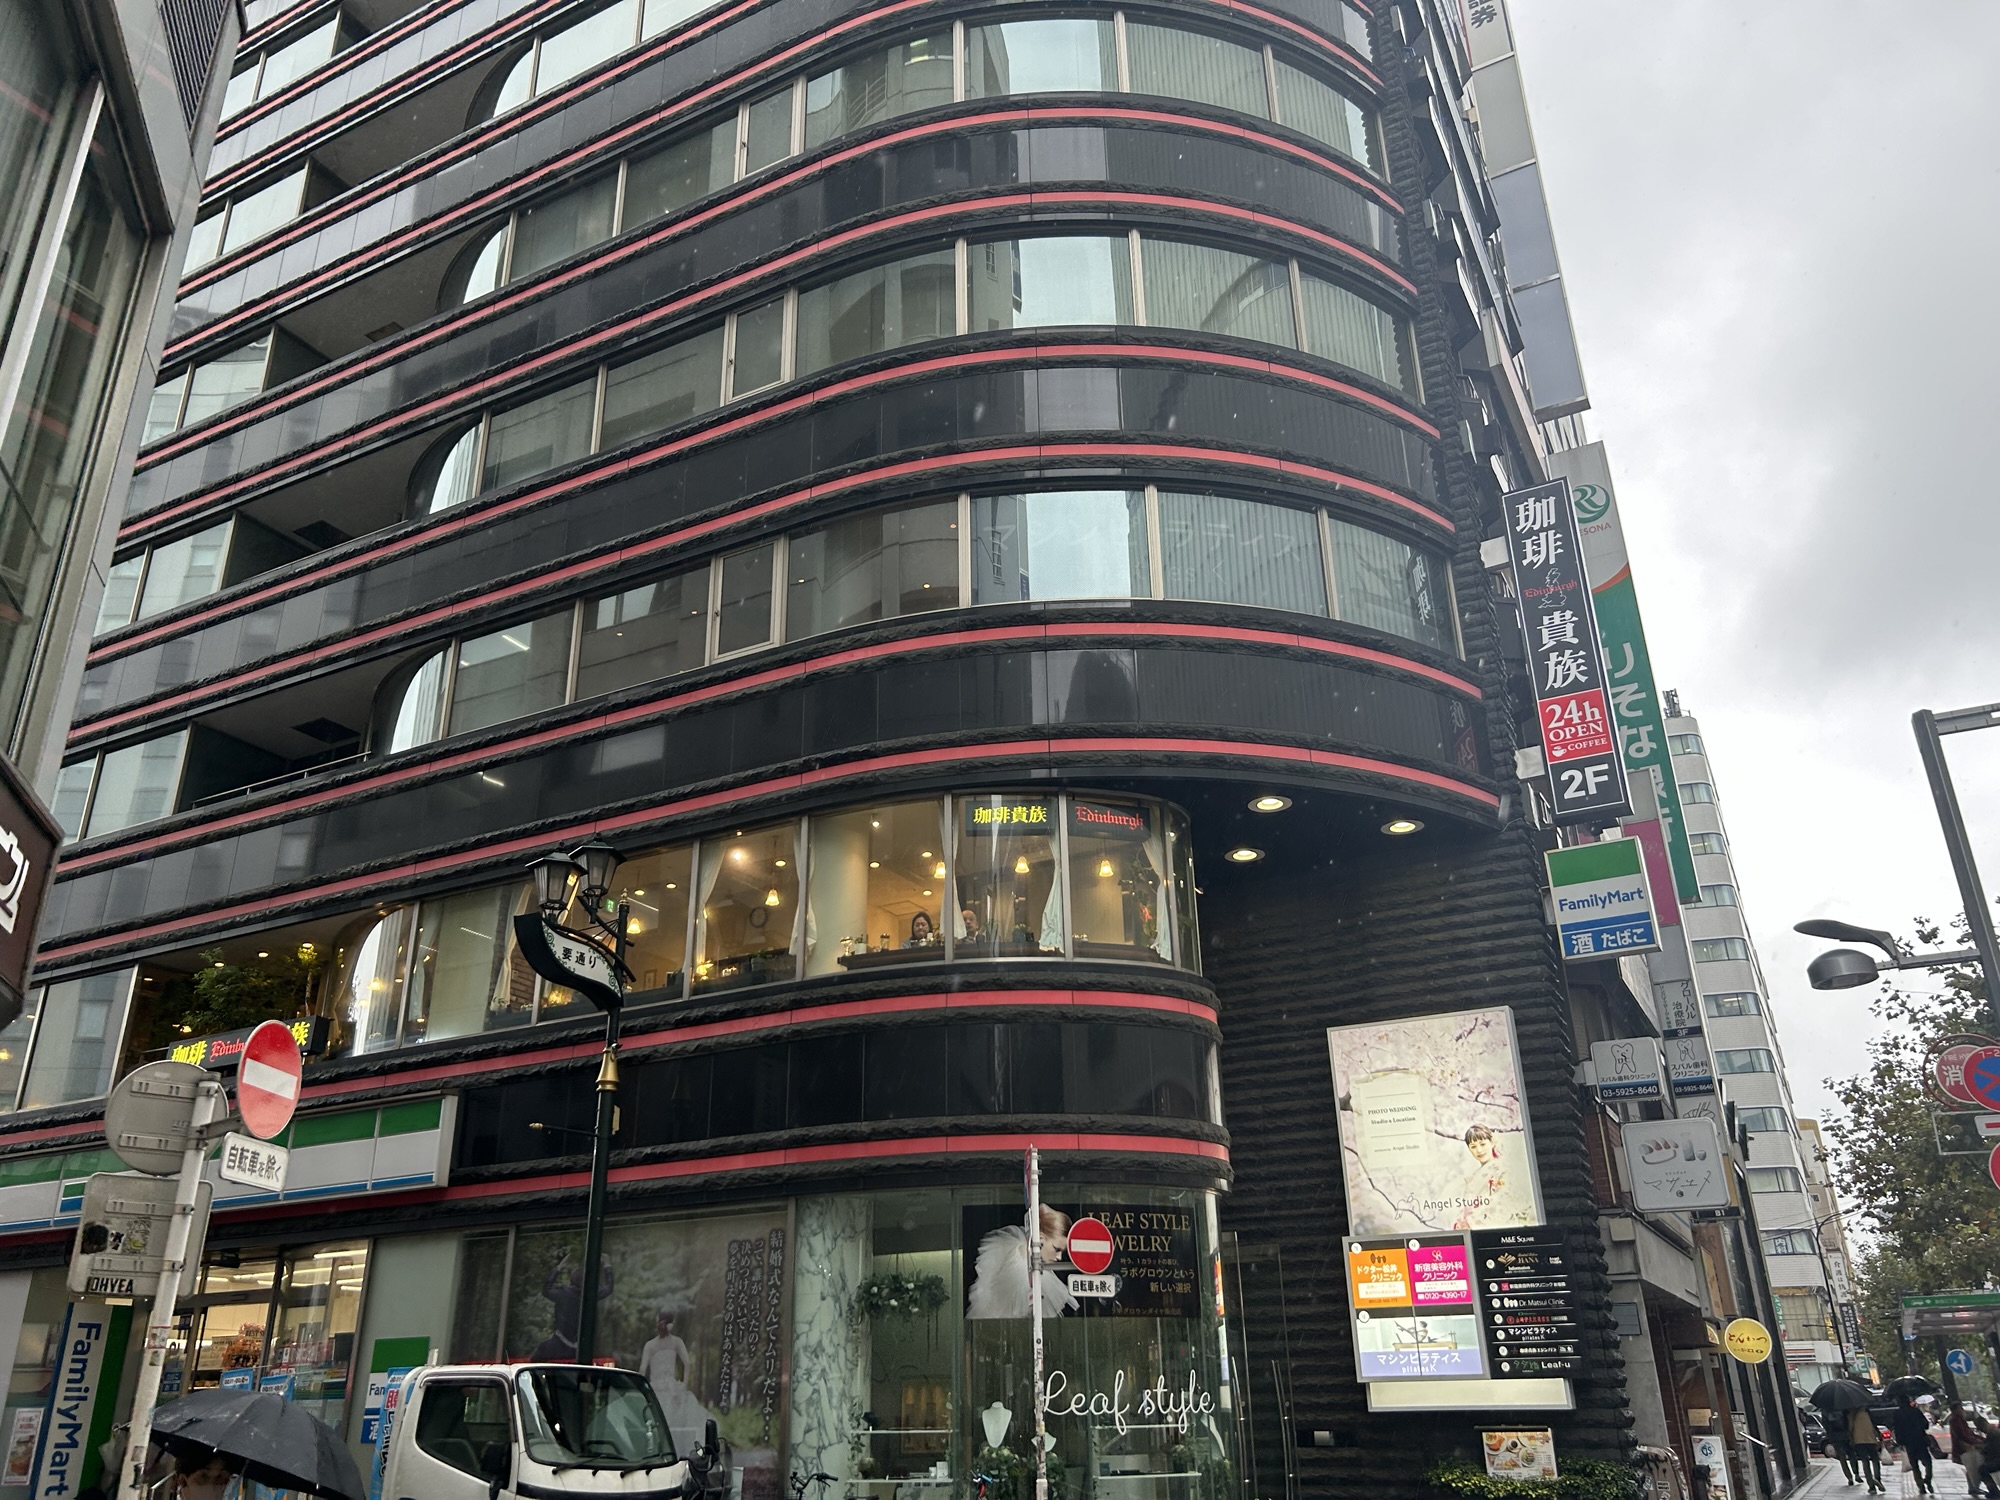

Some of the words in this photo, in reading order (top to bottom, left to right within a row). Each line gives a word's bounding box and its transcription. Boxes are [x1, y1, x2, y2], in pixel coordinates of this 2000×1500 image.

[1515, 497, 1564, 569] 珈琲
[1579, 522, 1611, 536] ESONA
[1524, 579, 1577, 598] Edinburgh
[1537, 610, 1588, 690] 貴族
[1546, 700, 1602, 728] 24h
[1549, 721, 1603, 741] OPEN
[1568, 738, 1607, 750] COFFEE
[1561, 764, 1608, 799] 2F
[973, 805, 1047, 823] 珈琲貴族
[1076, 806, 1143, 830] Edinburgh
[1559, 888, 1644, 911] FamilyMart
[1571, 933, 1594, 953] 酒
[1601, 928, 1647, 948] たばこ
[562, 946, 597, 969] 要通り
[1681, 981, 1696, 1019] グローバル
[1672, 1001, 1687, 1027] 治療院
[1677, 1029, 1688, 1037] 3F
[1979, 1050, 2000, 1059] 7-2
[1600, 1072, 1657, 1083] スバル歯科クリニック
[1674, 1069, 1708, 1078] クリニック
[1602, 1085, 1658, 1098] 03-5925-8640
[1388, 1105, 1417, 1113] WEDDING
[226, 1144, 281, 1182] 自転車を除く
[1423, 1198, 1453, 1212] Angel
[1455, 1196, 1490, 1209] Studio
[1715, 1209, 1725, 1217] B1
[1139, 1212, 1191, 1231] STYLE
[1113, 1234, 1172, 1252] WELRY
[1120, 1267, 1195, 1279] ラボグロウンという
[1357, 1264, 1398, 1275] ドクター松井
[1415, 1262, 1463, 1272] 新宿美容外科
[1371, 1273, 1402, 1282] クリニック
[1422, 1272, 1458, 1281] クリニック
[1072, 1280, 1112, 1293] 自転車を除く
[1150, 1281, 1192, 1293] 新しい選択
[1424, 1291, 1467, 1300] 0120-4390-17
[1728, 1333, 1768, 1344] とんかつ
[44, 1322, 102, 1497] FamilyMart
[1043, 1370, 1130, 1436] Leaf
[1138, 1369, 1216, 1434] style
